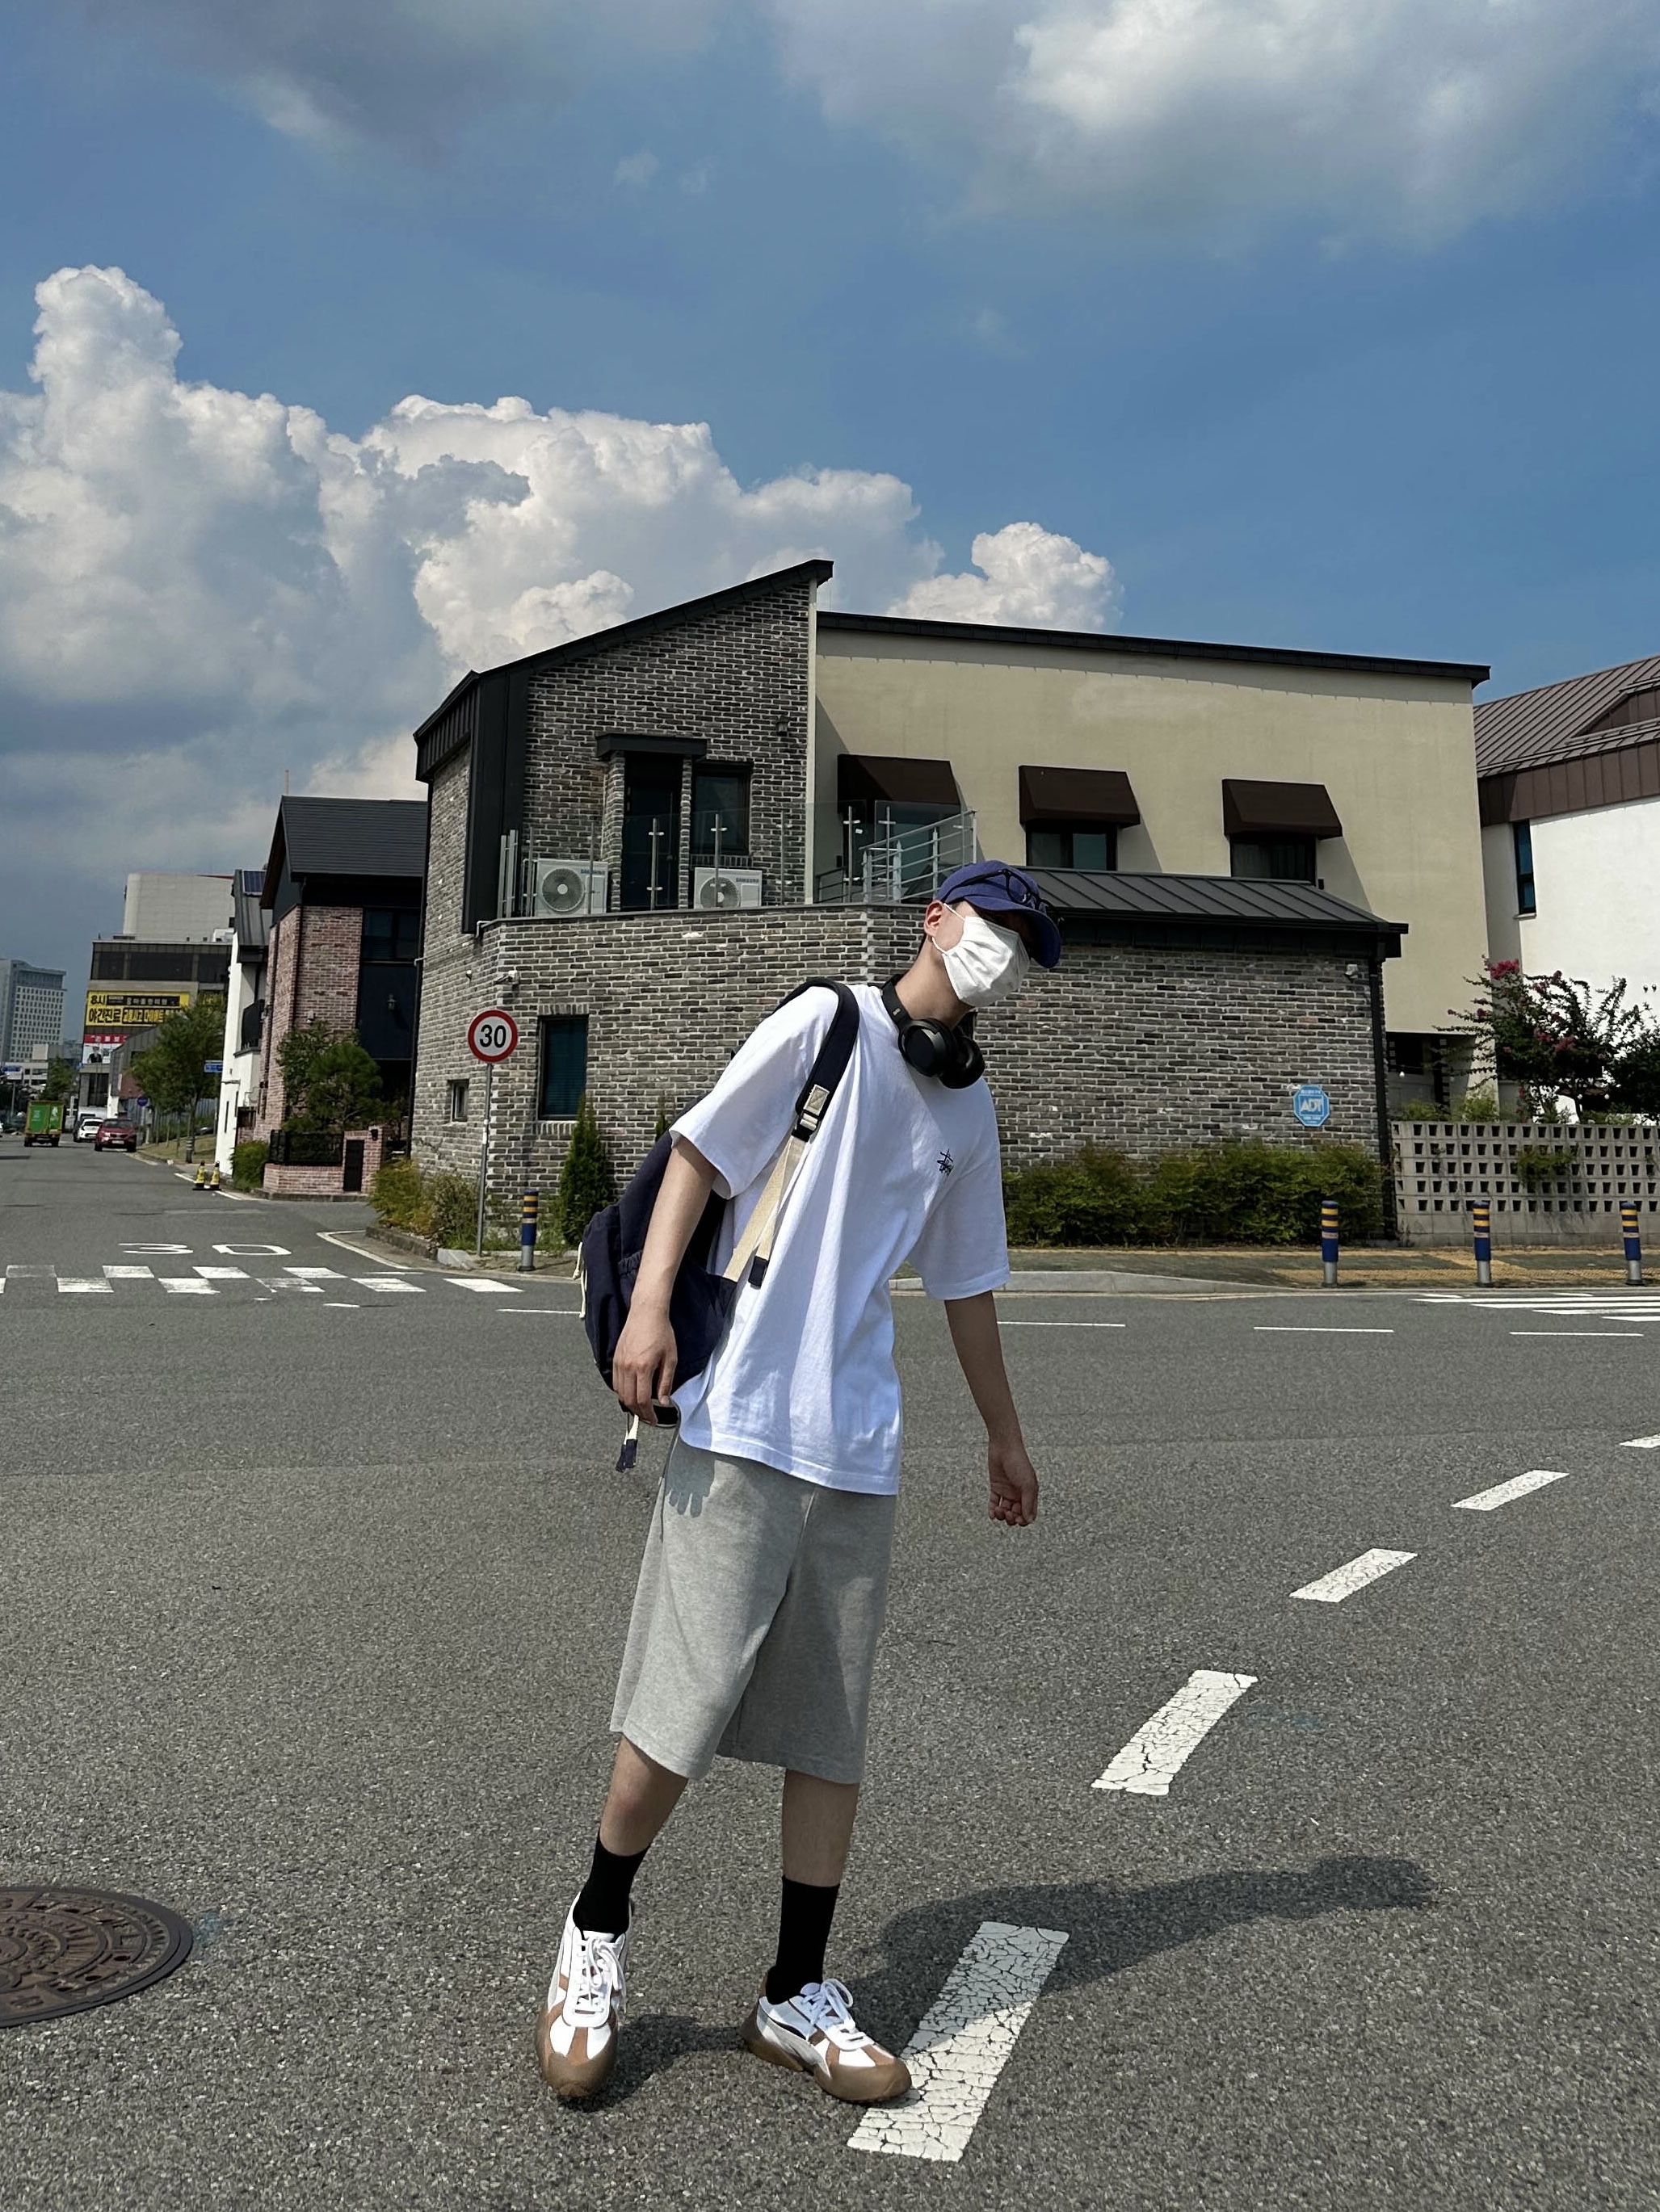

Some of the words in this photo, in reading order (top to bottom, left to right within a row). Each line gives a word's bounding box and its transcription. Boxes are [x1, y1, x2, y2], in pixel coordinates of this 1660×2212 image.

[90, 995, 105, 1005] 8시
[89, 1009, 121, 1023] 야간진료
[480, 1024, 506, 1048] 30
[1300, 1098, 1322, 1112] ADT
[118, 1243, 292, 1255] 30
